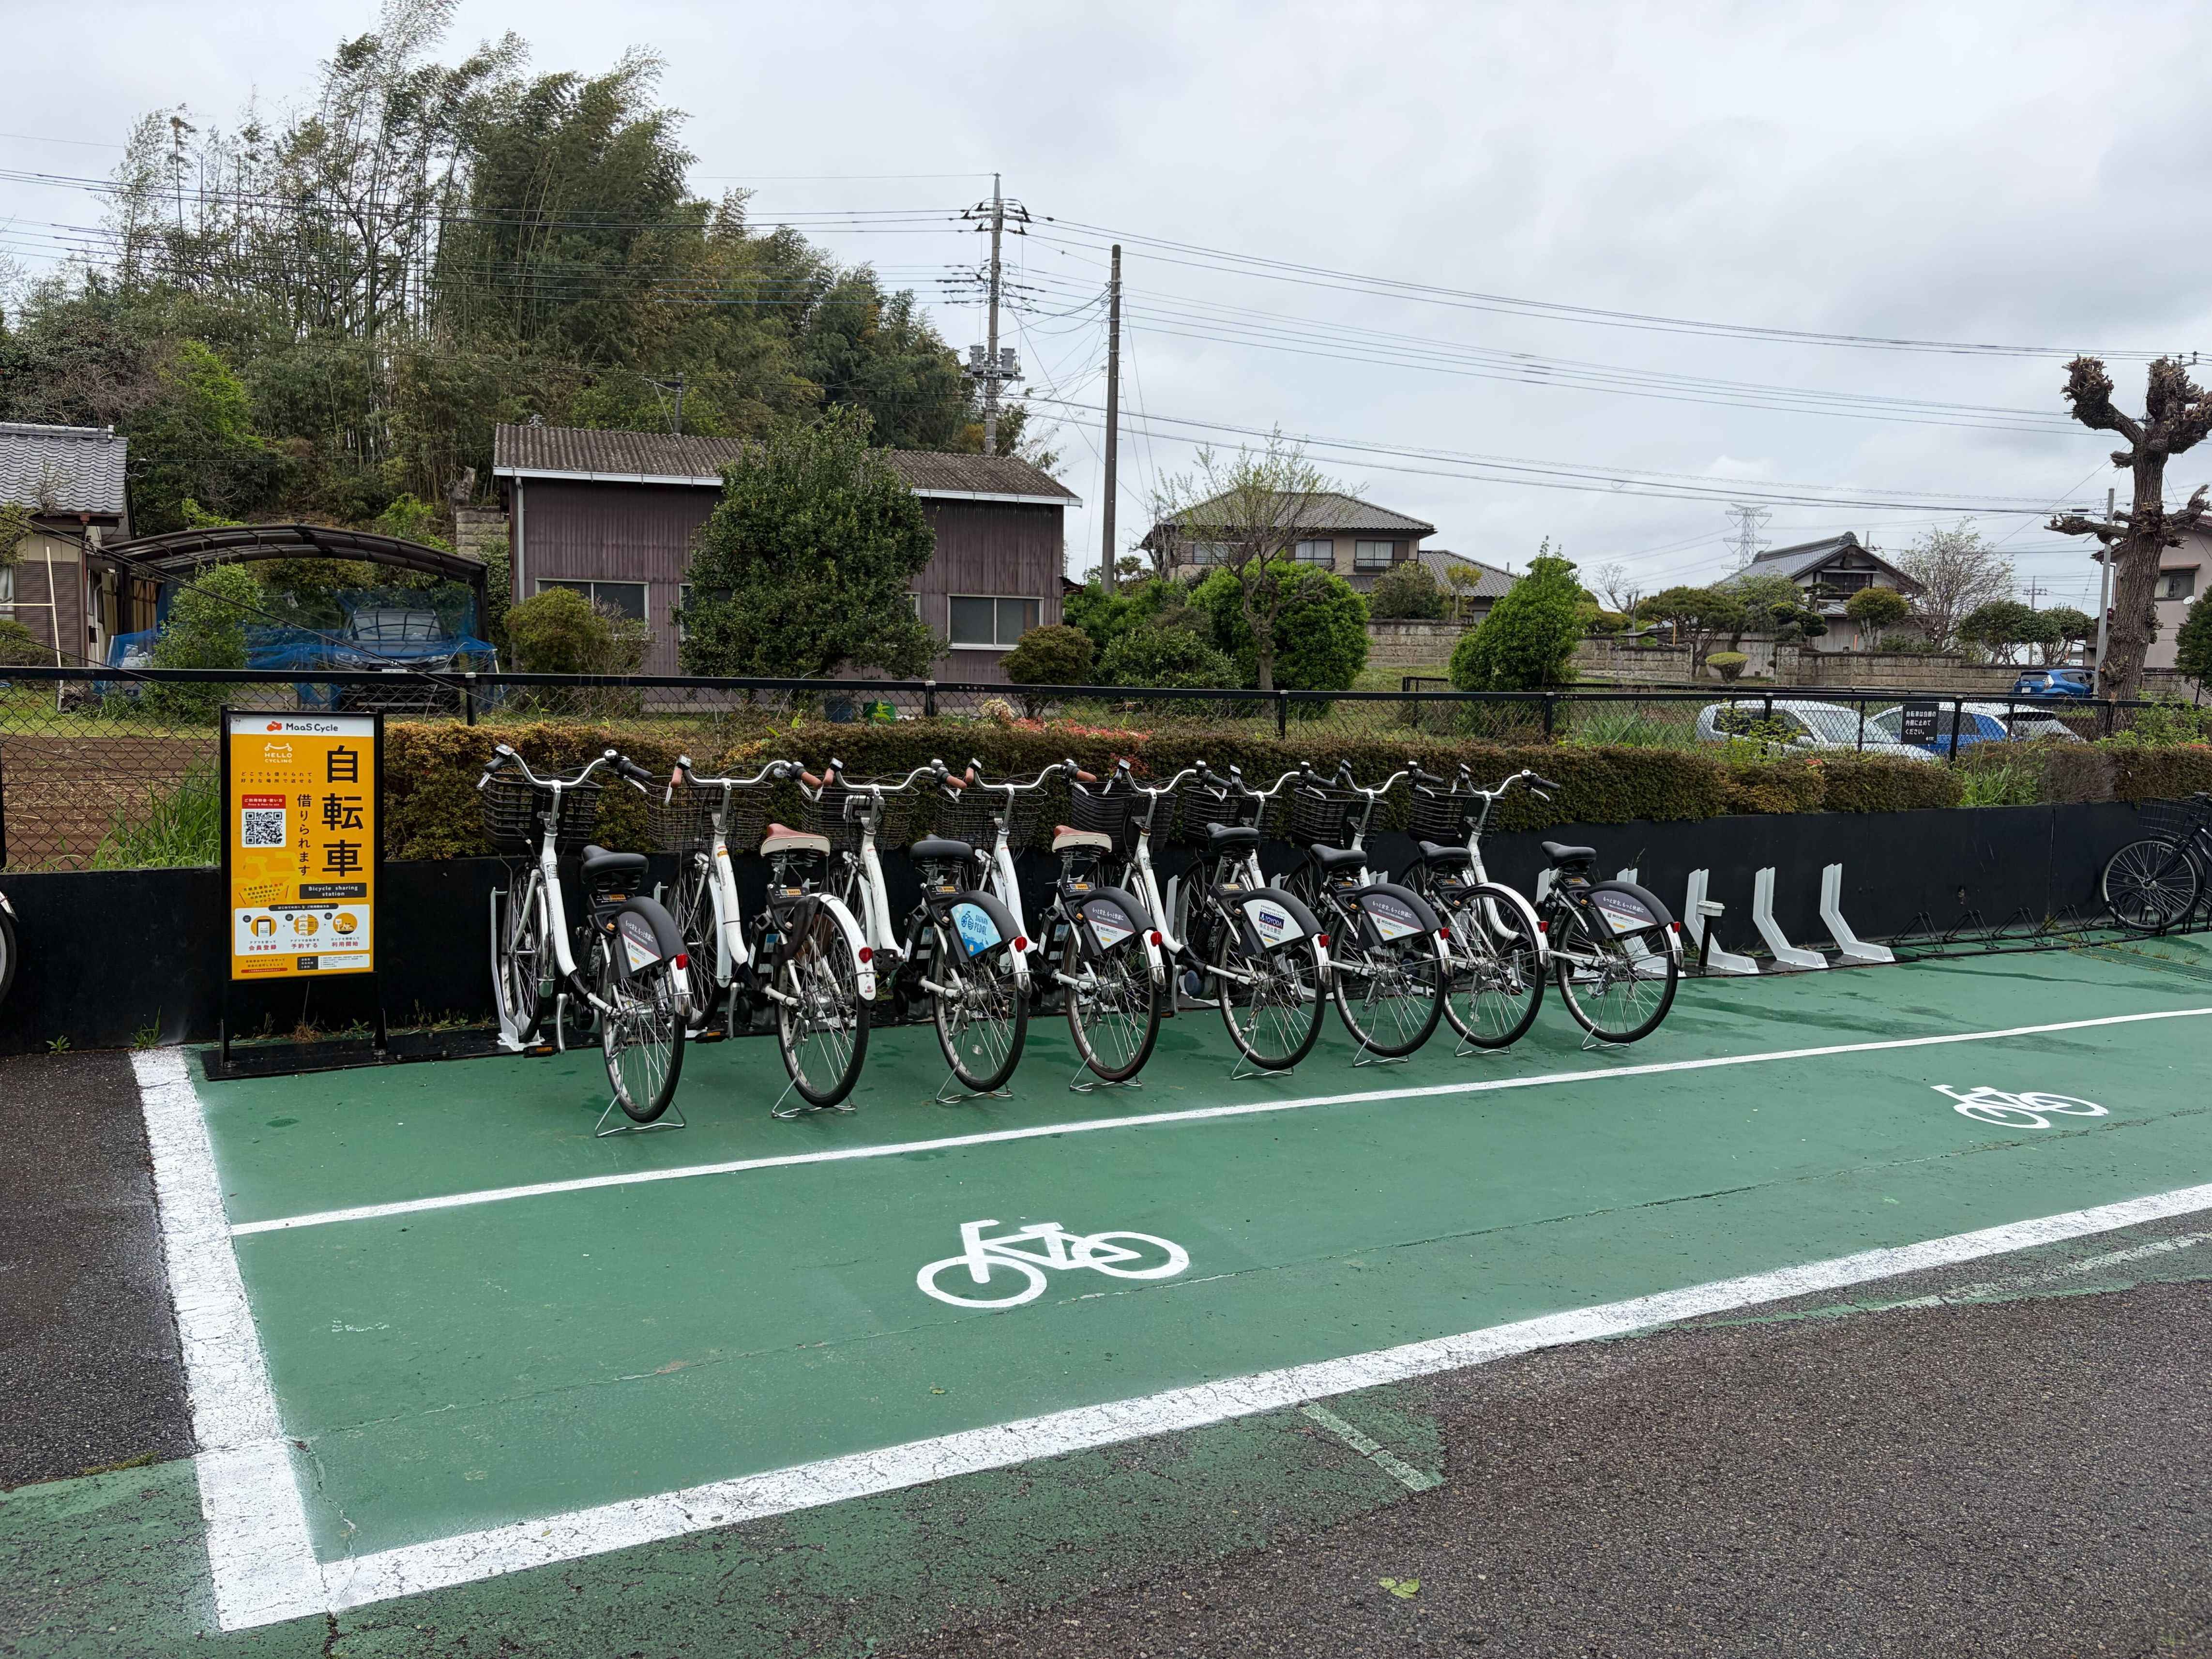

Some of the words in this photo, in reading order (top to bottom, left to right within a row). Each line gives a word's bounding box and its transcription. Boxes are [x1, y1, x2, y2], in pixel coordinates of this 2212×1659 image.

[315, 724, 338, 733] Cycle
[322, 745, 364, 877] 自転車
[297, 794, 312, 876] 借りられます
[1265, 916, 1282, 927] TOYODA
[974, 922, 987, 935] PEDAL
